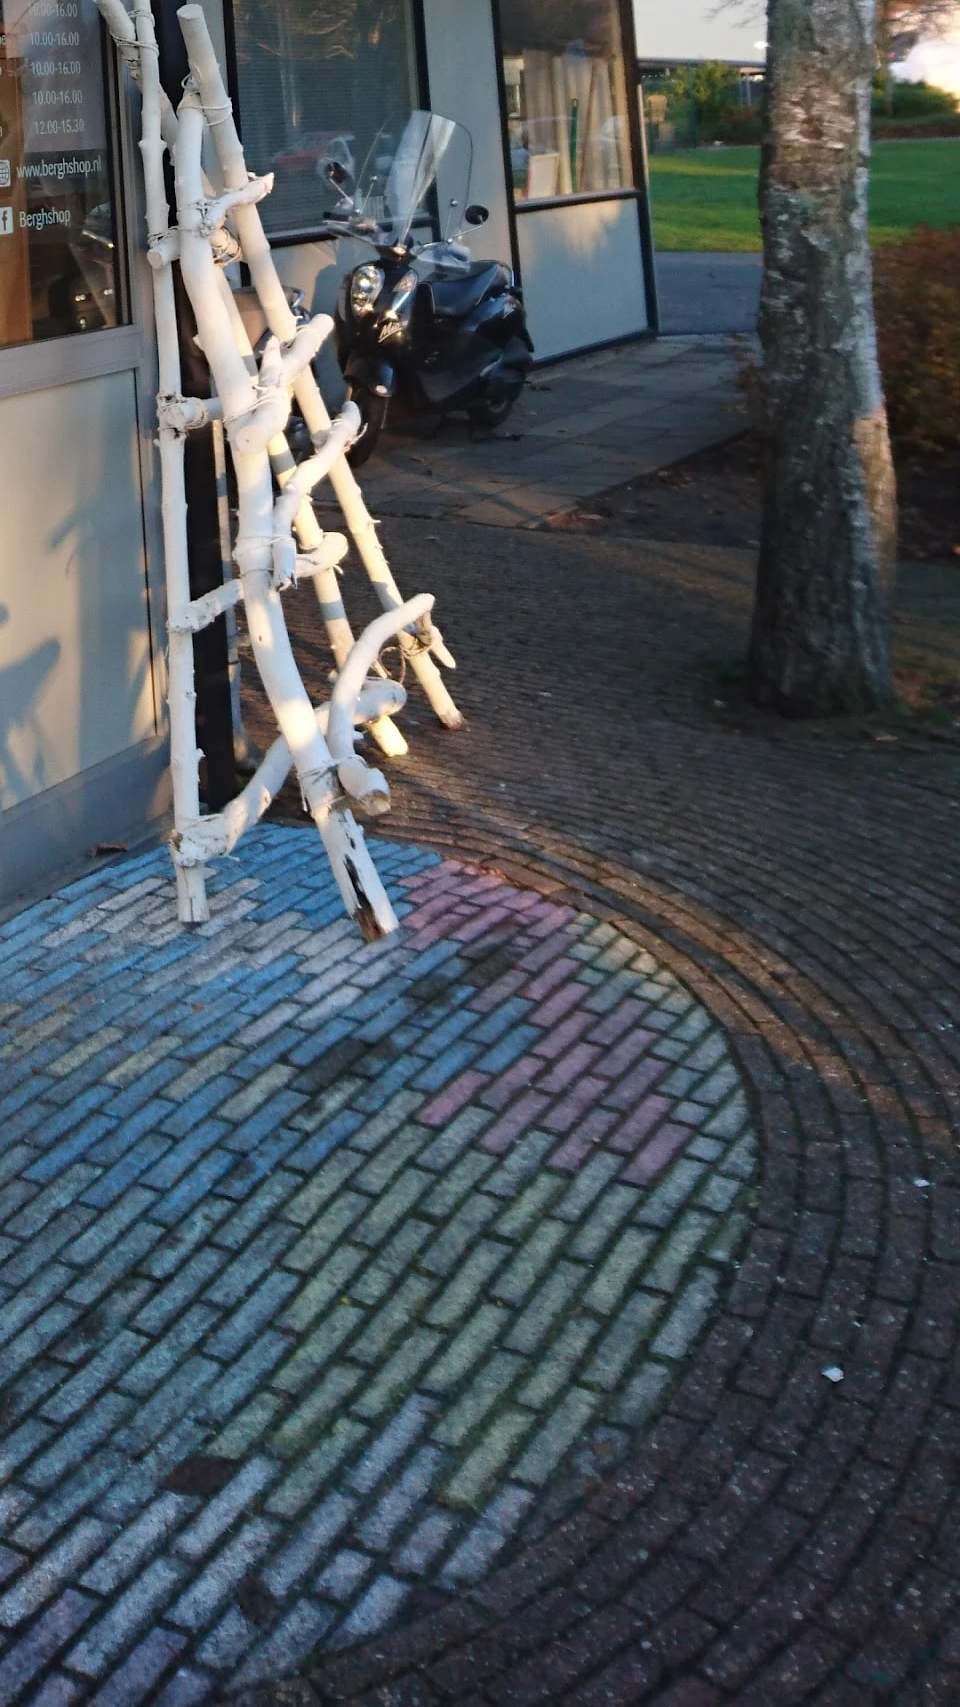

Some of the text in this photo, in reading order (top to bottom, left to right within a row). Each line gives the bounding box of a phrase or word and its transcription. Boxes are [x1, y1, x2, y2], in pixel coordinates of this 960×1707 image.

[30, 31, 80, 46] 10.00-16.00
[30, 60, 81, 76] 10.00-16.00
[32, 90, 83, 105] 10.00-16.00
[33, 119, 85, 135] 12.00-15.30
[16, 155, 102, 180] www.berghshop.nl
[19, 208, 71, 230] Berghshop
